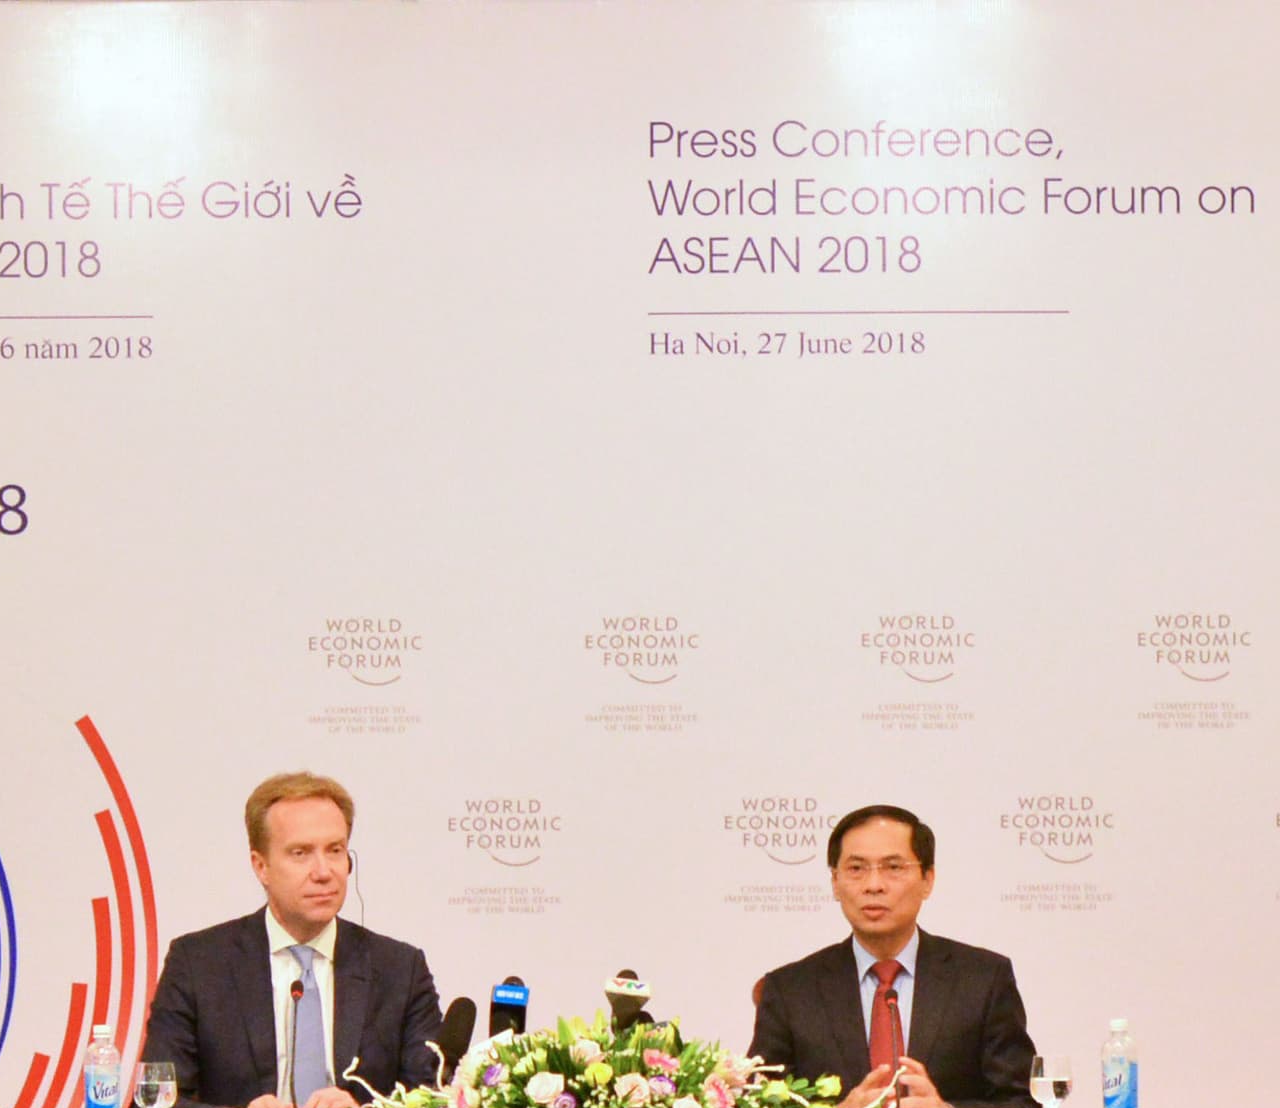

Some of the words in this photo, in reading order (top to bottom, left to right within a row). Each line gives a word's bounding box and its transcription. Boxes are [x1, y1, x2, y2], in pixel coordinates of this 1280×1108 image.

[648, 121, 757, 159] Press
[772, 120, 1064, 161] Conference,
[40, 176, 91, 221] Tế
[105, 175, 185, 220] Thế
[200, 178, 290, 220] Giới
[306, 173, 363, 219] về
[647, 178, 777, 216] World
[794, 177, 1026, 216] Economic
[1043, 177, 1181, 215] Forum
[1197, 185, 1256, 215] on
[647, 235, 800, 275] ASEAN
[817, 235, 922, 274] 2018
[0, 336, 16, 361] 6
[23, 338, 79, 361] năm
[87, 335, 153, 360] 2018
[649, 331, 686, 356] Ha
[695, 331, 748, 359] Noi,
[757, 331, 788, 356] 27
[797, 331, 853, 359] June
[861, 331, 926, 355] 2018
[326, 619, 402, 633] WORLD
[603, 617, 679, 631] WORLD
[879, 616, 955, 630] WORLD
[1155, 615, 1231, 629] WORLD
[308, 636, 423, 651] ECONOMIC
[585, 634, 700, 649] ECONOMIC
[861, 633, 976, 648] ECONOMIC
[1137, 632, 1252, 647] ECONOMIC
[327, 654, 402, 668] FORUM
[604, 652, 679, 666] FORUM
[880, 651, 955, 665] FORUM
[1156, 650, 1231, 664] FORUM
[465, 800, 541, 814] WORLD
[742, 798, 818, 812] WORLD
[1018, 797, 1094, 811] WORLD
[447, 817, 562, 832] ECONOMIC
[724, 815, 836, 830] ECONOMIC
[1000, 814, 1115, 829] ECONOMIC
[466, 835, 541, 849] FORUM
[743, 833, 818, 847] FORUM
[1019, 832, 1094, 846] FORUM
